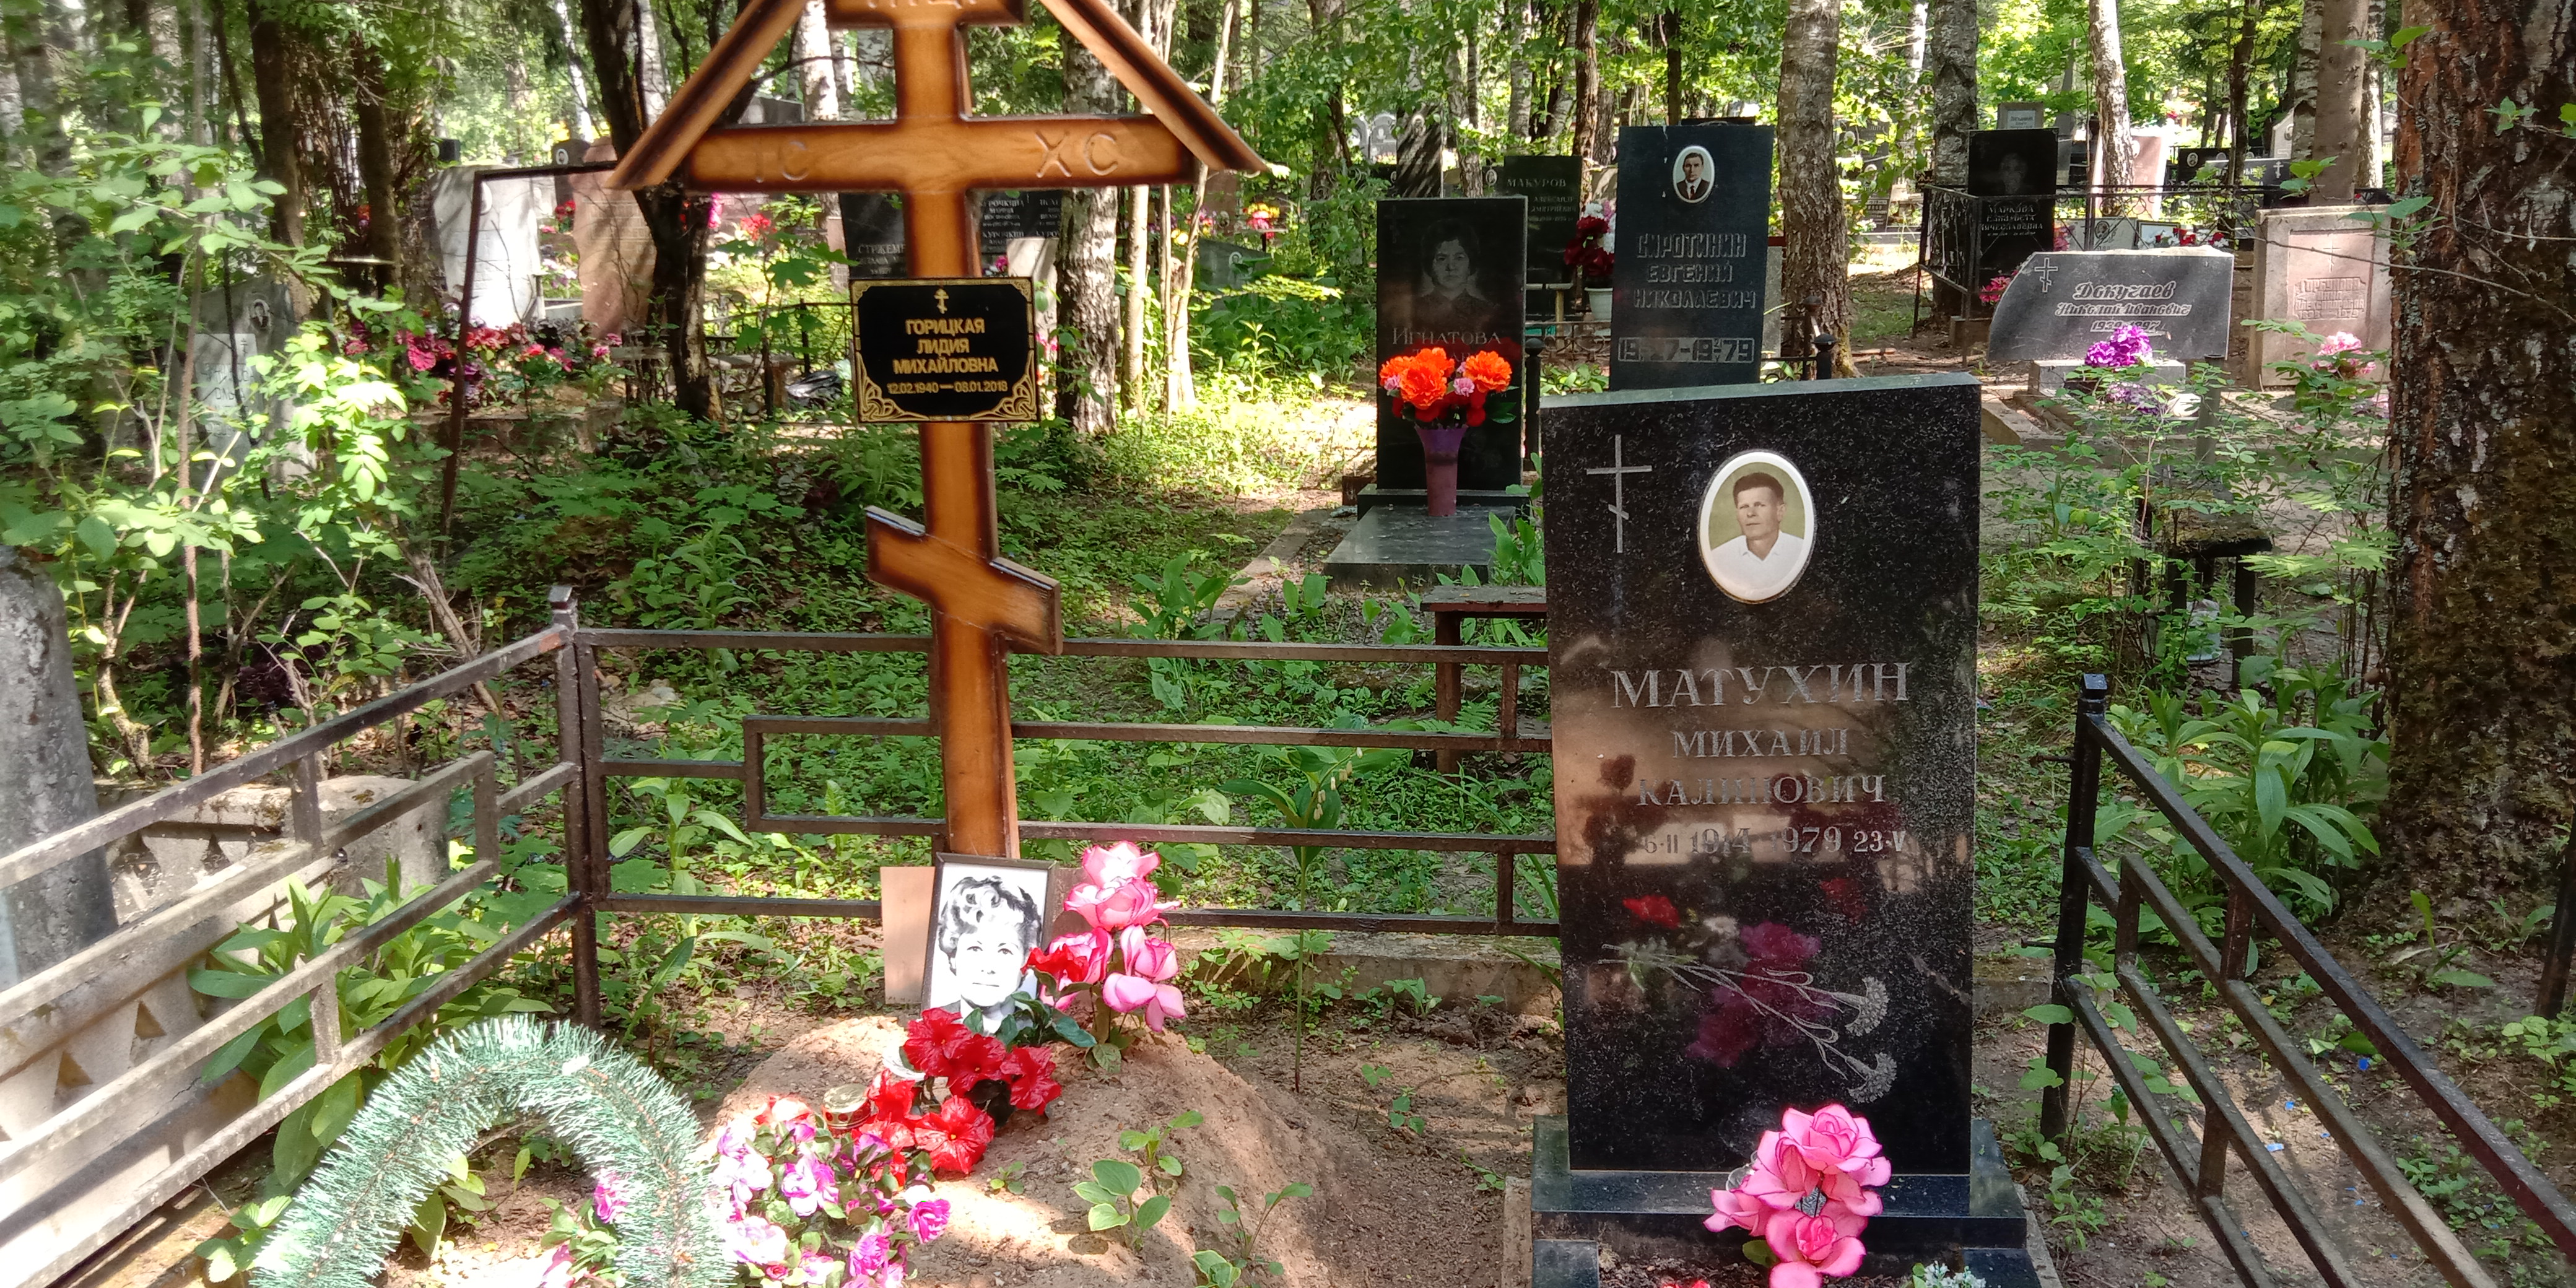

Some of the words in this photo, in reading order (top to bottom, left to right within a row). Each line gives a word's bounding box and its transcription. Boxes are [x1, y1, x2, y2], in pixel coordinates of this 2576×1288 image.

[1646, 260, 1733, 283] ЕВГЕНИЙ
[1633, 289, 1756, 309] НИКОЛАЕВИЧ
[2073, 281, 2176, 301] Докучаев
[905, 318, 985, 336] ГОРИЦКАЯ
[917, 338, 970, 355] ЛИДИЯ
[893, 355, 999, 374] МИХАЙЛОВНА
[1611, 662, 1911, 708] МАТУХИН
[1671, 728, 1849, 759] МИХАИЛ
[1636, 775, 1886, 806] КАЛИНОВИЧ
